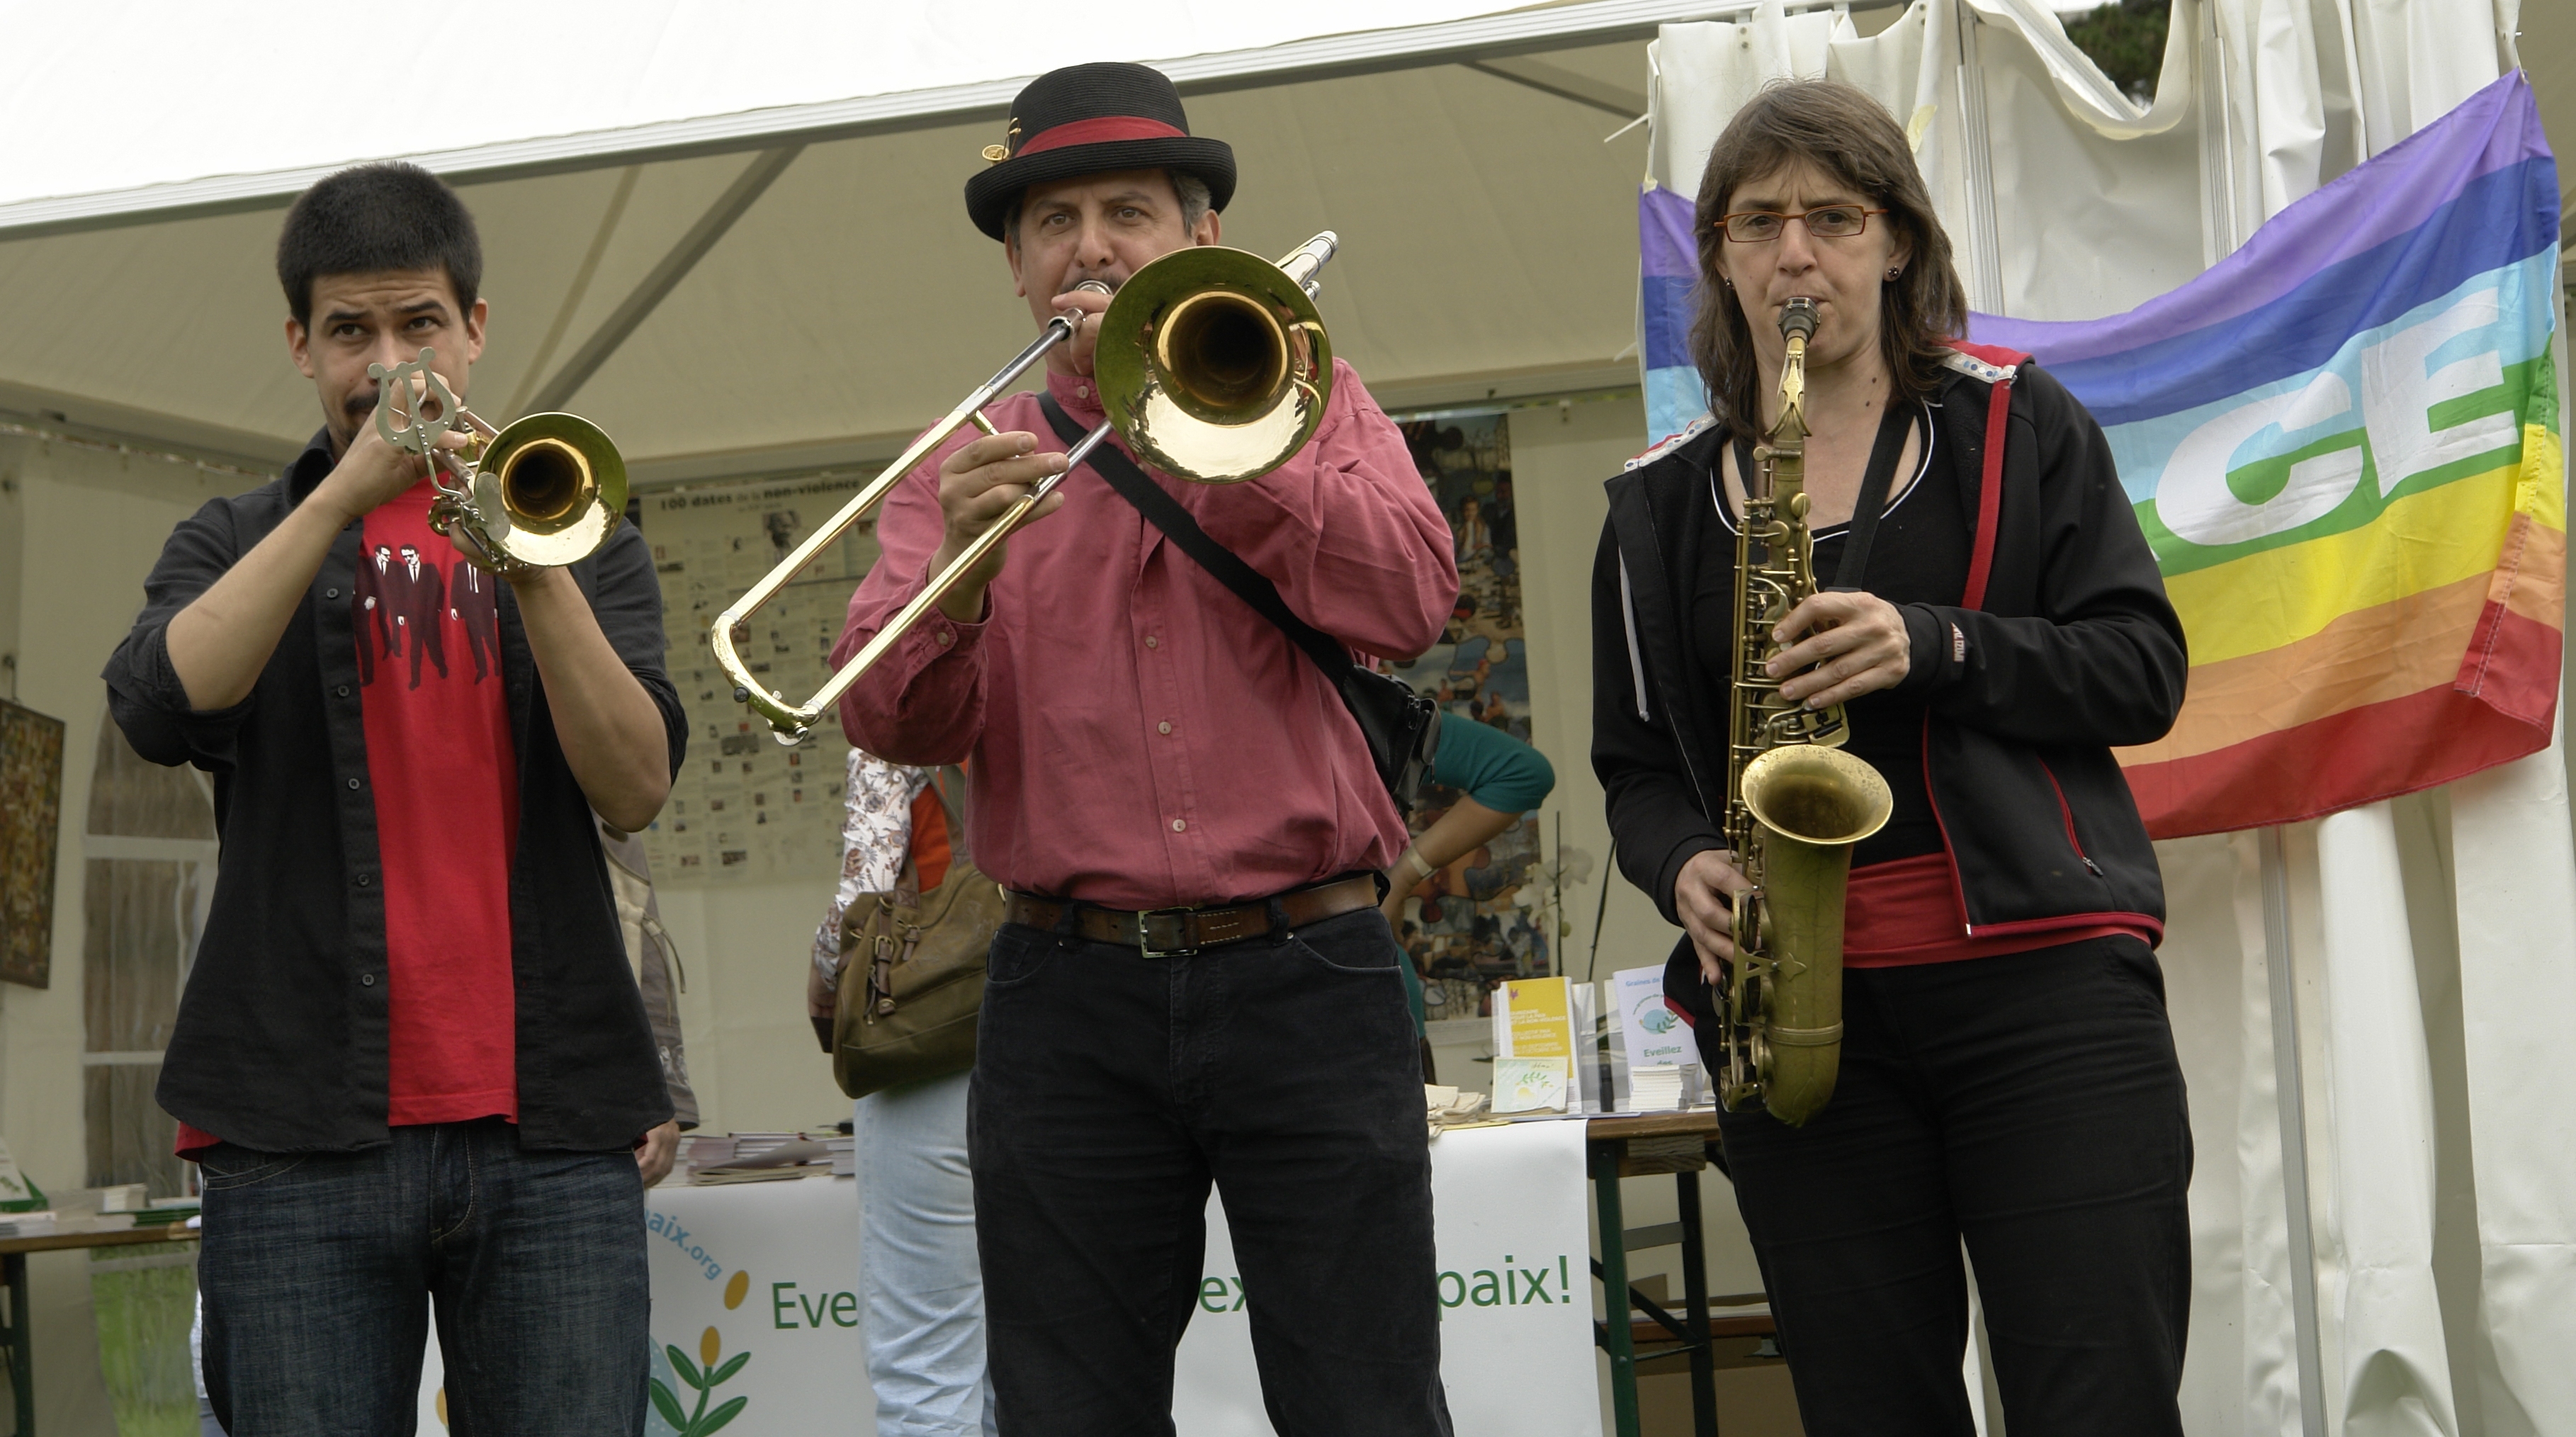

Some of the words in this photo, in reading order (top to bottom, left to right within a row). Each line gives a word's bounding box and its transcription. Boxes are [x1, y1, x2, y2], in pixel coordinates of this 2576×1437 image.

[2150, 287, 2519, 560] CE
[661, 496, 687, 509] 100
[692, 494, 732, 507] dates
[764, 479, 860, 499] non-violence
[1953, 640, 1965, 662] IZUMI
[1644, 1046, 1683, 1057] Eveillez
[772, 1281, 859, 1329] Eve
[1199, 1276, 1246, 1314] ex
[1437, 1255, 1571, 1322] paix!
